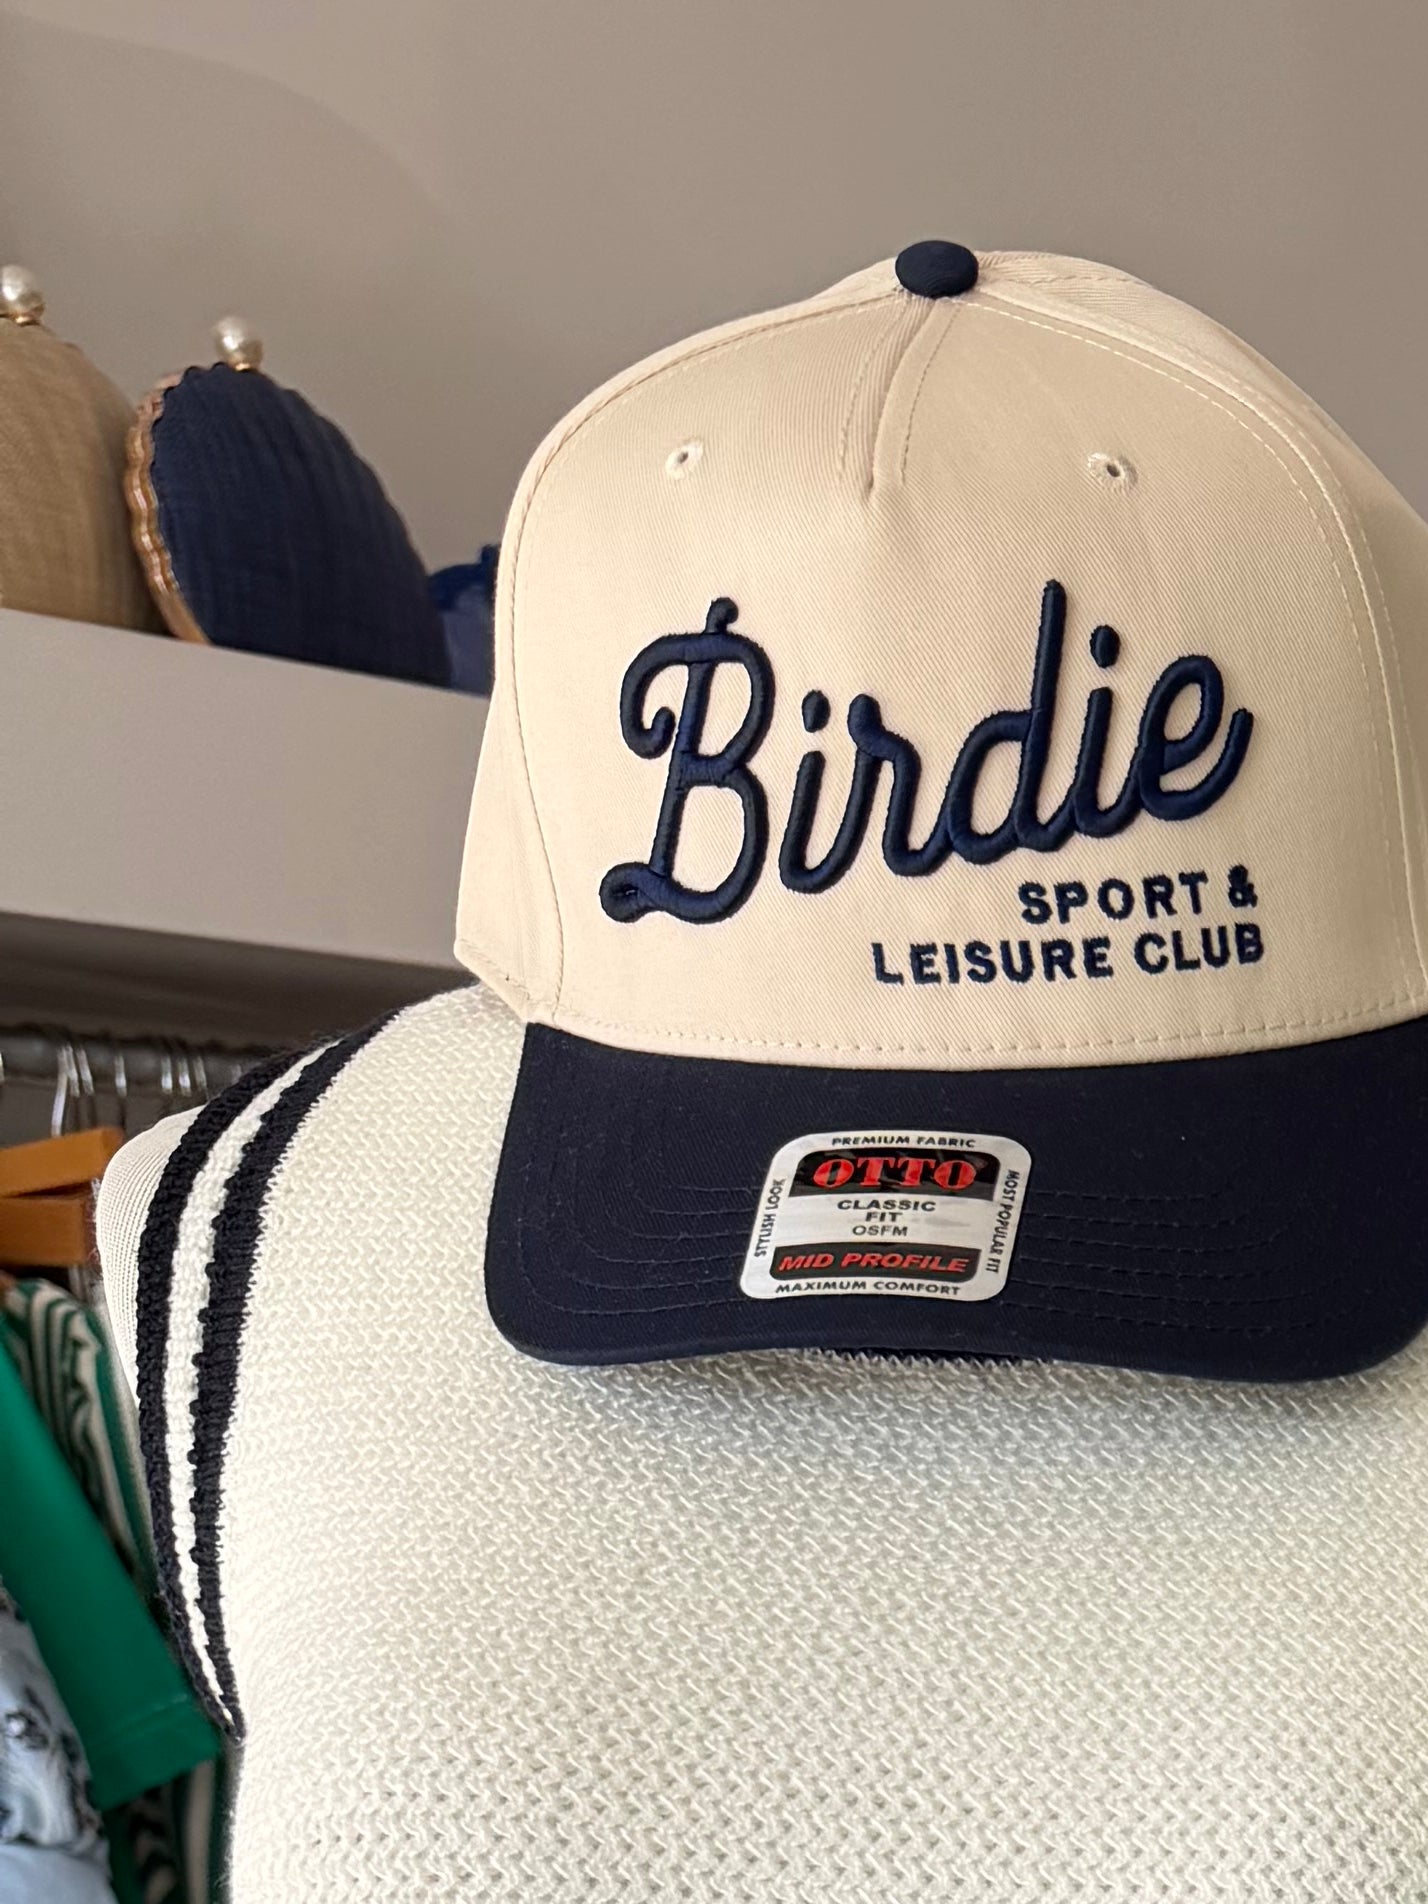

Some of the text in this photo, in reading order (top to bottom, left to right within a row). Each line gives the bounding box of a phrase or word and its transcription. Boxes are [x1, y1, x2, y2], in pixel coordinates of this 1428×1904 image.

[599, 580, 1253, 924] Birdie
[1018, 865, 1258, 926] SPORT &
[871, 922, 1264, 985] LEISURE CLUB
[832, 1136, 976, 1148] PREMIUM FABRIC
[812, 1157, 977, 1190] OTTO
[755, 1179, 785, 1257] STYLISH LOOK
[837, 1199, 936, 1211] CLASSIC
[865, 1212, 903, 1222] FIT
[852, 1225, 908, 1237] OSFM
[986, 1170, 1020, 1274] MOST POPULAR FIT
[778, 1253, 970, 1273] MID PROFILE
[776, 1281, 961, 1296] MAXIMUM COMFORT
